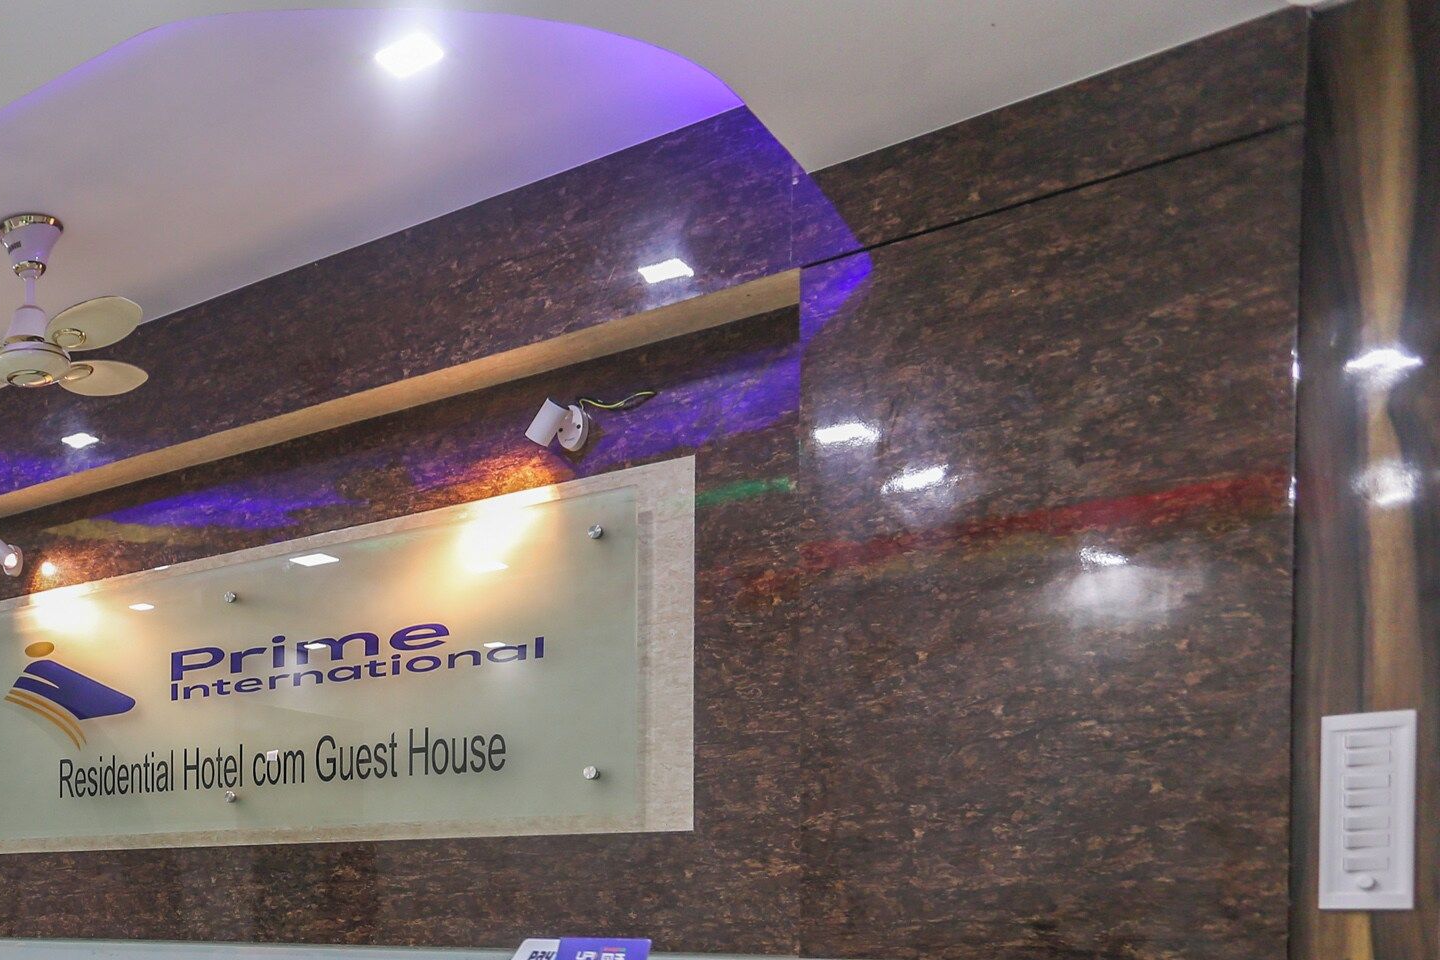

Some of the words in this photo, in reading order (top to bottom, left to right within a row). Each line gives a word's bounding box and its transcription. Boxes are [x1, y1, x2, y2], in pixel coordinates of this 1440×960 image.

[170, 622, 451, 682] Prime
[170, 636, 545, 701] International
[59, 749, 174, 799] Residential
[183, 743, 244, 791] Hotel
[252, 749, 306, 787] com
[315, 733, 398, 783] Guest
[408, 727, 507, 777] House
